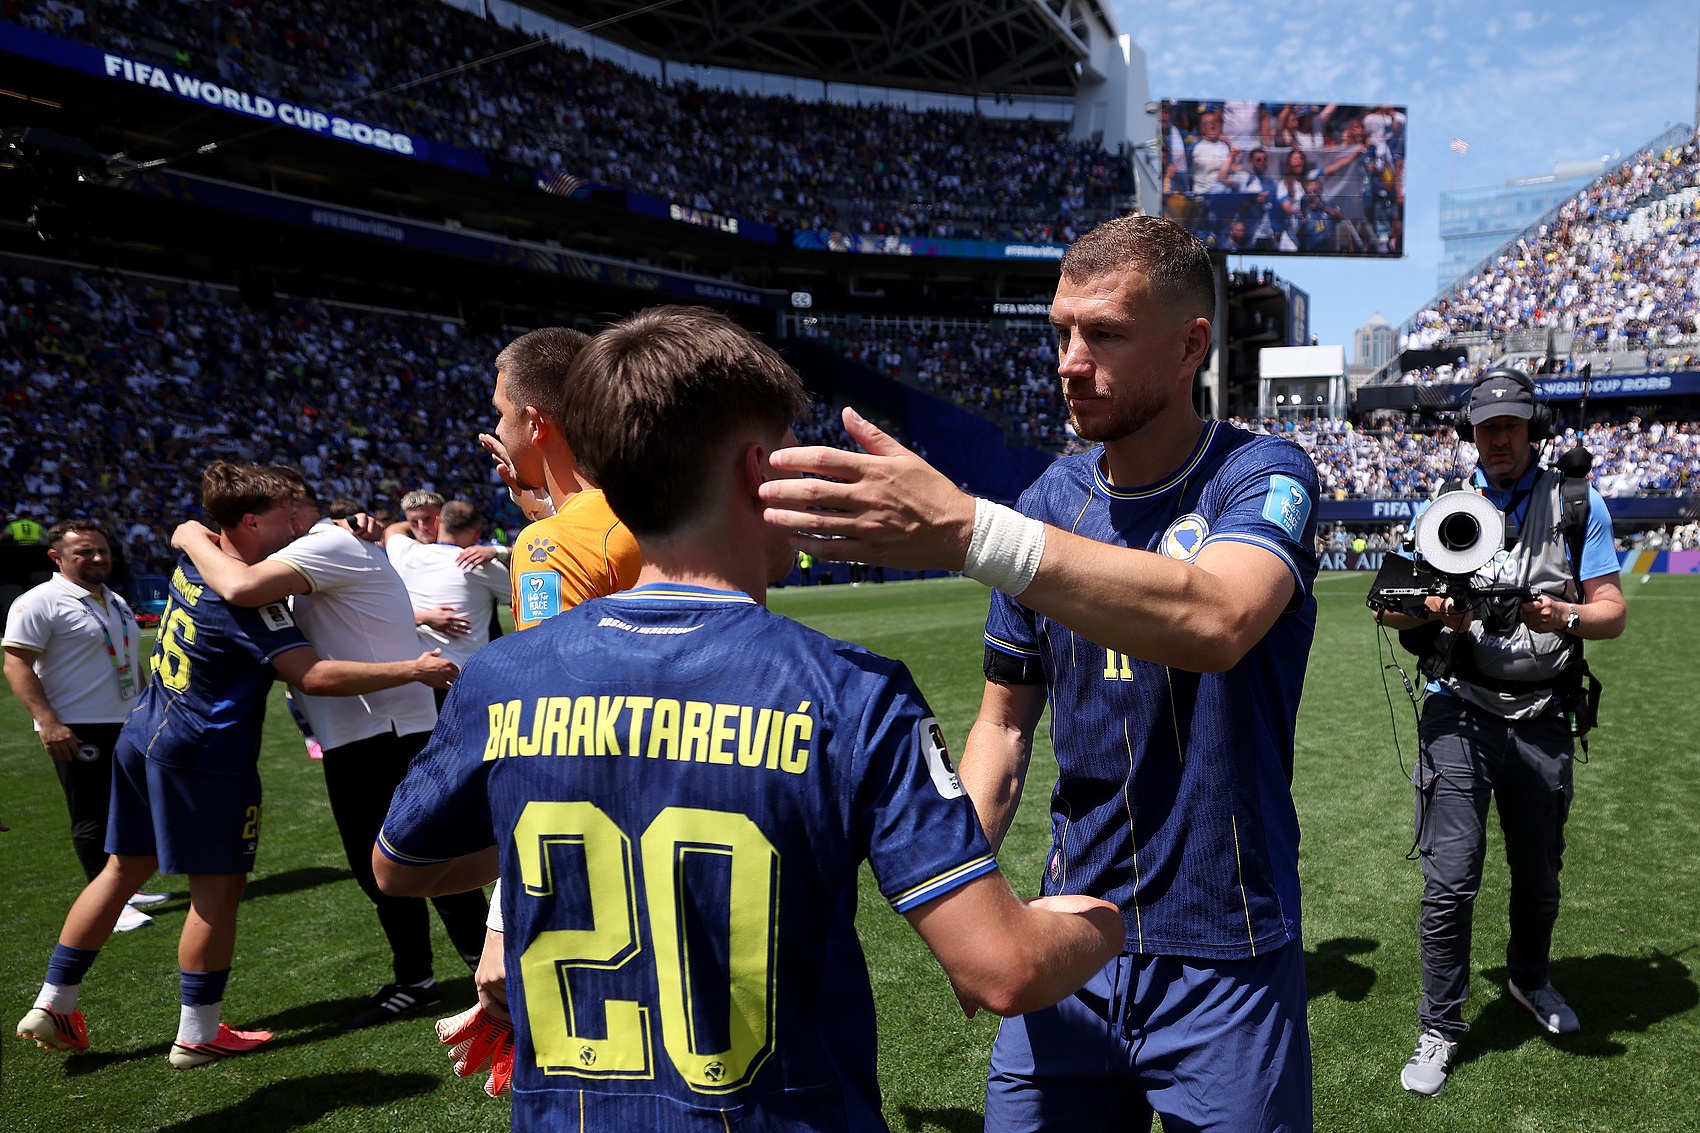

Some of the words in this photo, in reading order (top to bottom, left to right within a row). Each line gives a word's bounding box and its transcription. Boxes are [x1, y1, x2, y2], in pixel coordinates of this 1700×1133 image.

[104, 53, 174, 92] FIFA
[173, 72, 276, 119] WORLD
[277, 102, 330, 133] CUP
[330, 117, 415, 155] 2026
[669, 203, 739, 234] SEATTLE
[694, 283, 760, 304] SEATTLE
[993, 303, 1017, 315] FIFA
[1593, 379, 1621, 393] CUP
[1621, 376, 1672, 392] 2026
[1373, 502, 1411, 517] FIFA
[529, 601, 548, 610] PEACE
[482, 695, 814, 775] BAJRAKTAREVIĆ
[513, 801, 782, 1095] 20
